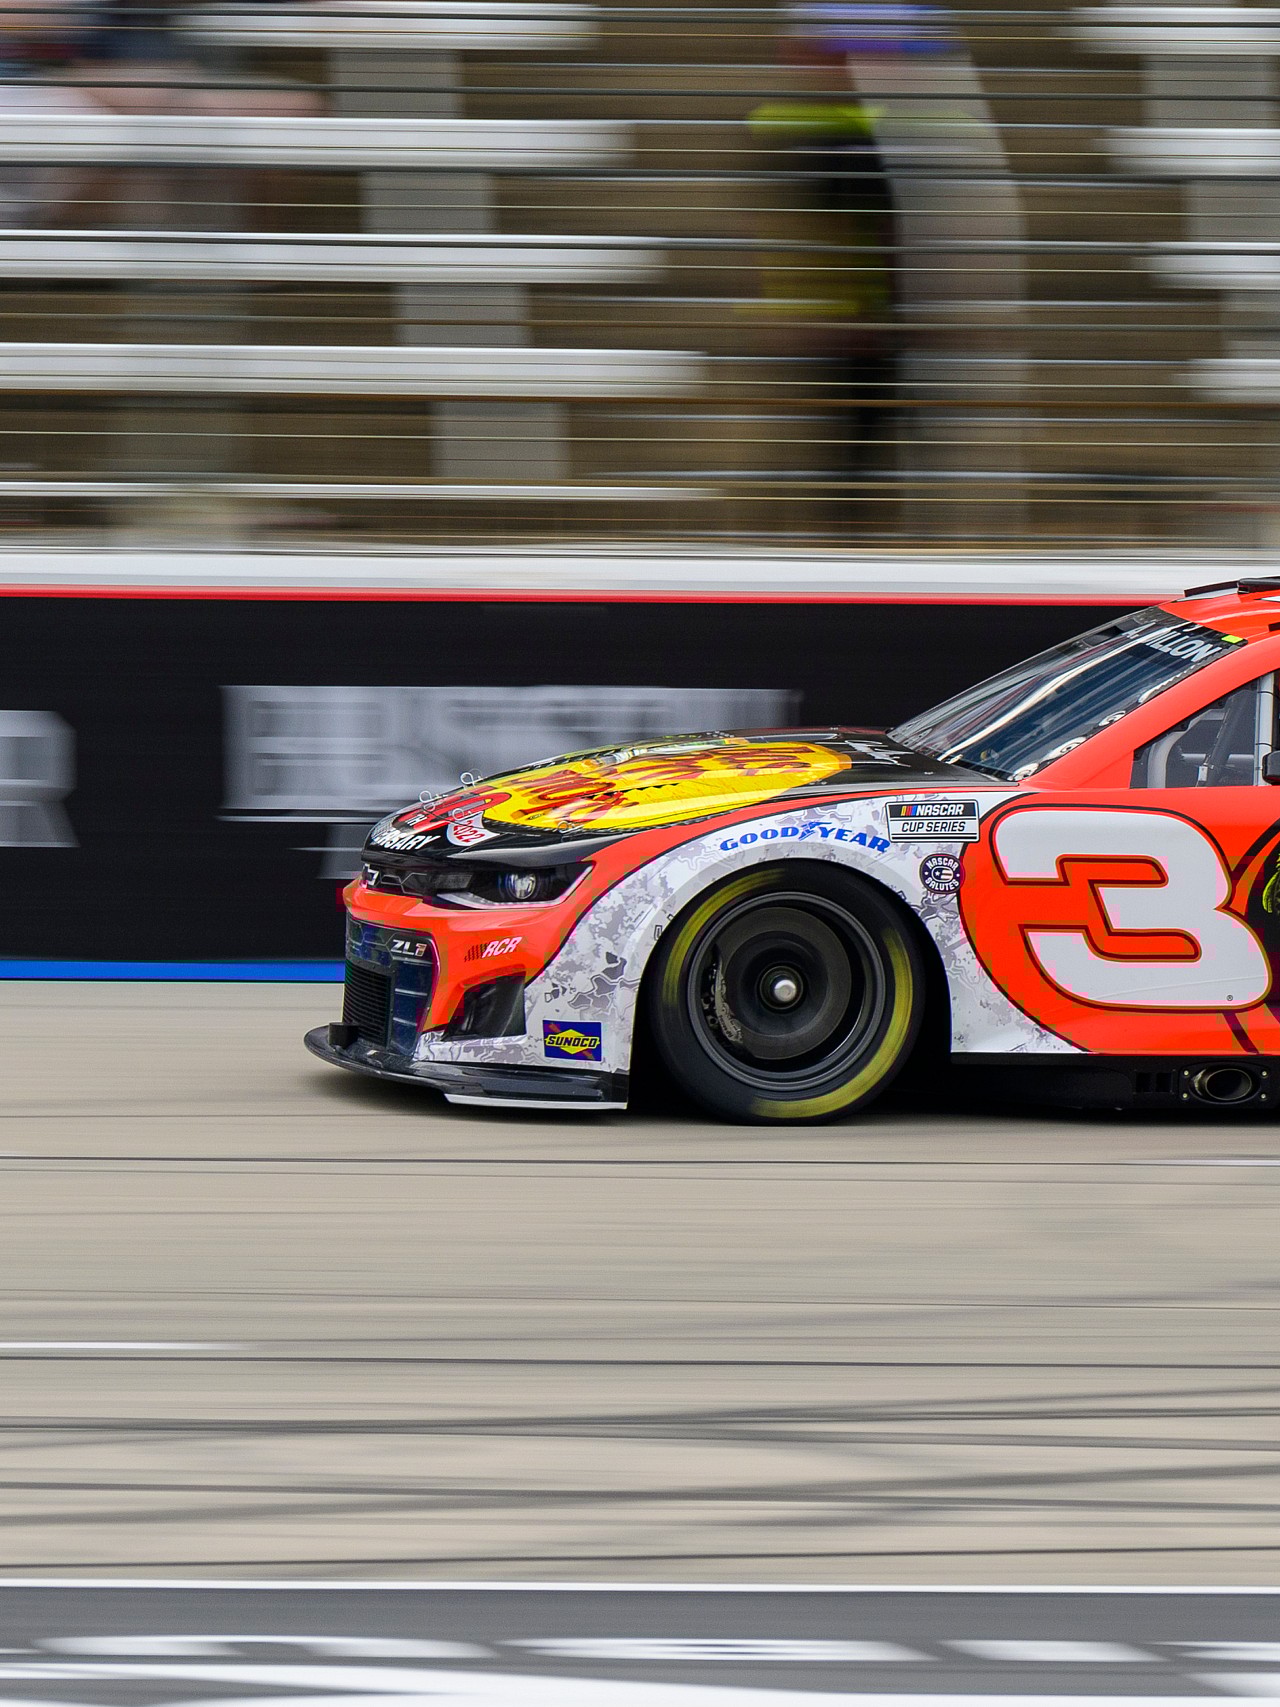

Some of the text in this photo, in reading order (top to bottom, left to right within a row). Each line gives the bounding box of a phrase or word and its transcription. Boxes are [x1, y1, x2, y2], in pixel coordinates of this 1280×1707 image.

[914, 803, 965, 816] NASCAR
[453, 820, 486, 843] 2022
[901, 821, 966, 833] CUP SERIES
[719, 823, 891, 853] GOODYEAR
[925, 857, 959, 871] NASCAR
[925, 876, 960, 891] SALUTES
[992, 808, 1272, 1010] 3
[390, 939, 428, 957] ZL1
[546, 1036, 600, 1048] SUNOCO
